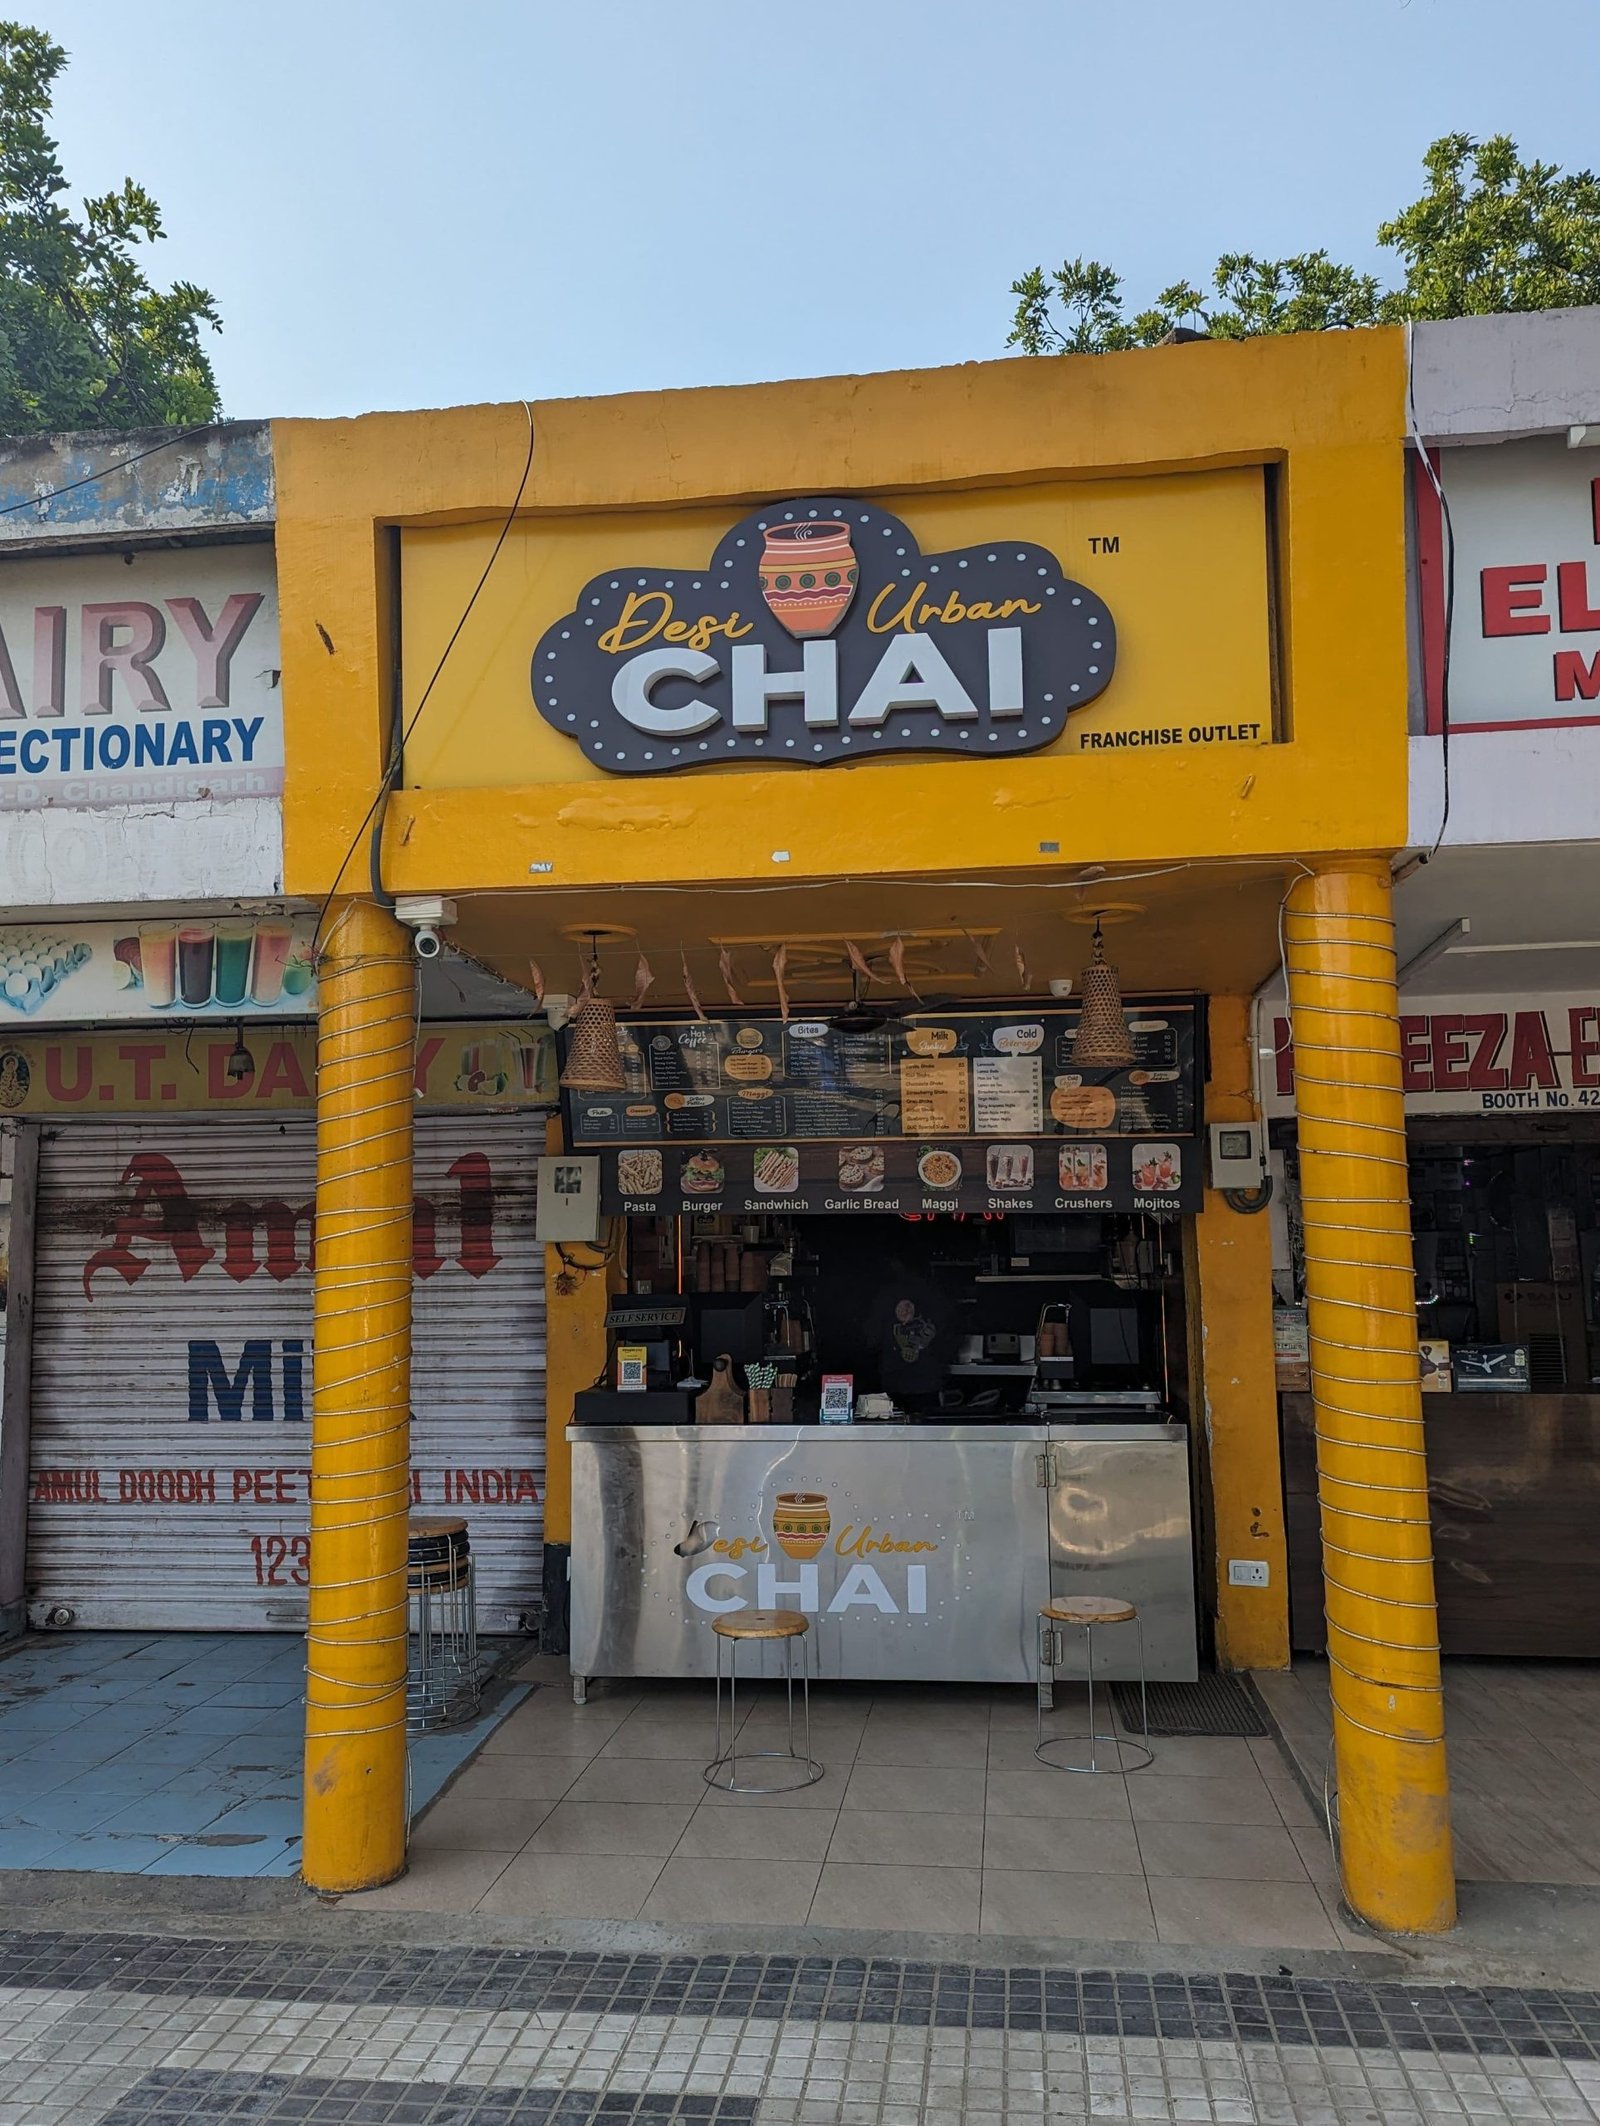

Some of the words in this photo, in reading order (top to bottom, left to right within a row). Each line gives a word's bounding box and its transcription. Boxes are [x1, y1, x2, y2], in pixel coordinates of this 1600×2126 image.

[1089, 537, 1121, 554] TM
[598, 590, 754, 655] Desi
[867, 580, 1041, 635] Urban
[610, 627, 1025, 737] CHAI
[0, 717, 265, 775] ECTIONARY
[1080, 729, 1184, 749] FRANCHISE
[1188, 723, 1262, 744] OUTLET
[798, 1026, 820, 1035] Bites
[931, 1031, 949, 1041] Milk
[1016, 1028, 1038, 1039] Cold
[998, 1037, 1040, 1051] Beverages
[45, 1048, 178, 1102] U.T.
[1482, 1092, 1540, 1109] BOOTH
[623, 1201, 656, 1212] Pasta
[682, 1200, 723, 1213] Burger
[744, 1199, 809, 1211] Sandwhich
[824, 1198, 862, 1210] Garlic
[863, 1198, 900, 1210] Bread
[922, 1199, 959, 1213] Maggi
[988, 1198, 1034, 1210] Shakes
[1054, 1197, 1113, 1209] Crushers
[1133, 1197, 1181, 1211] Mojitos
[609, 1313, 635, 1324] SELF
[635, 1311, 679, 1323] SERVICE
[119, 1468, 217, 1503] DOODH
[443, 1468, 539, 1505] INDIA
[835, 1525, 939, 1559] Urban
[686, 1562, 927, 1614] CHAI
